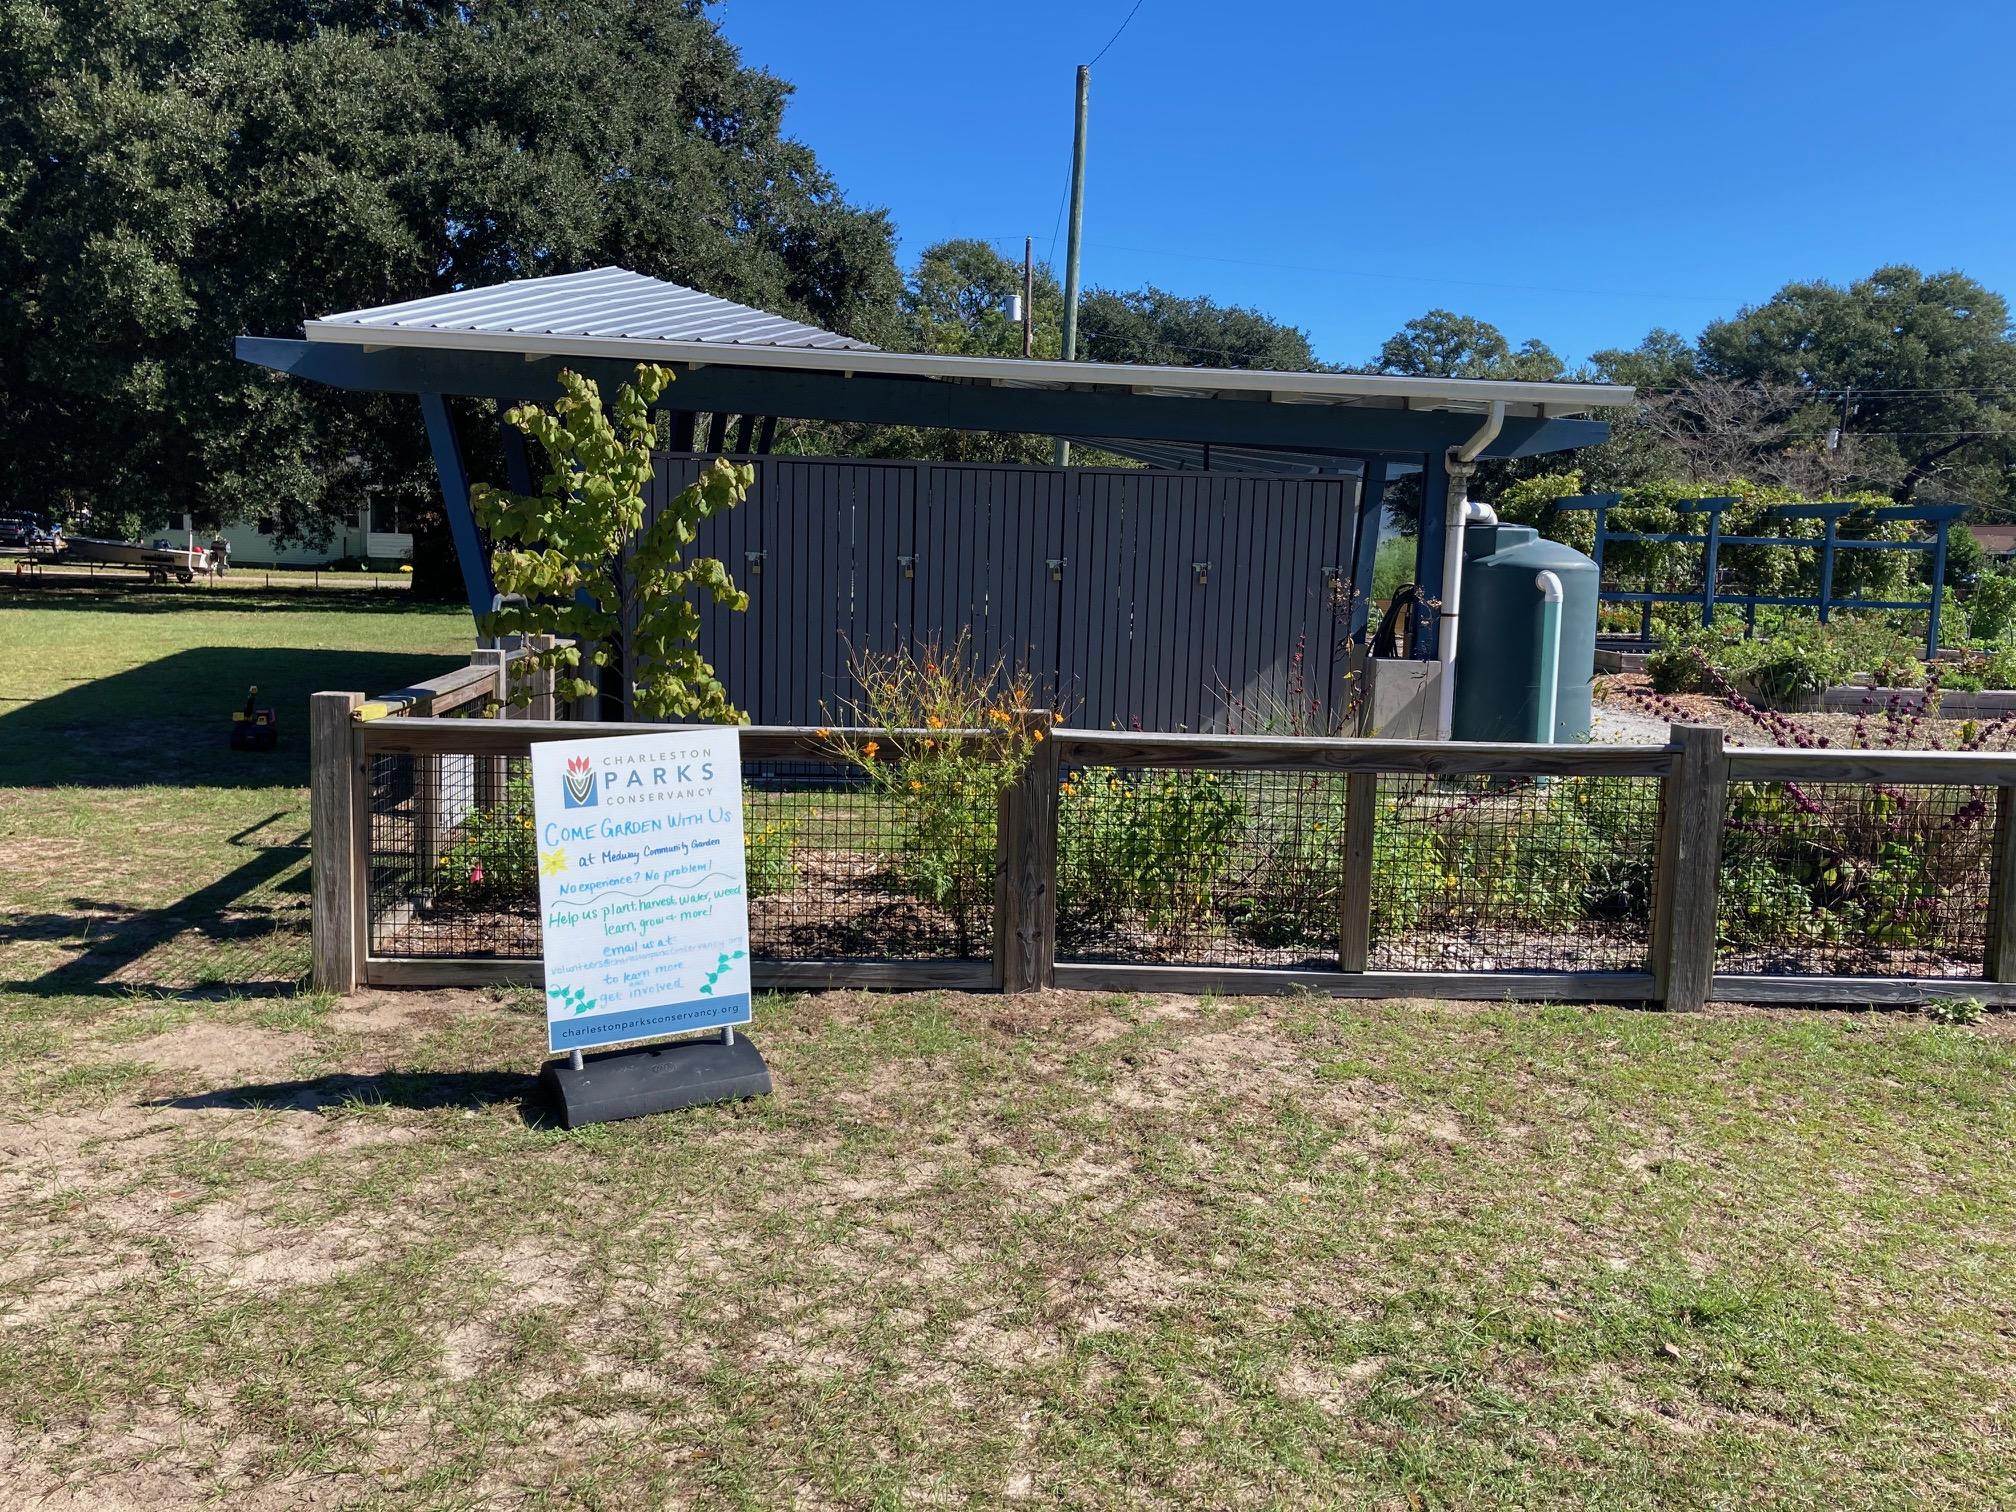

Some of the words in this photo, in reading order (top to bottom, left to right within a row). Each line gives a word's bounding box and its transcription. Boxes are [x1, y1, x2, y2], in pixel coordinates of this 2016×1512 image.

[602, 748, 712, 767] CHARLESTON
[604, 762, 714, 790] PARKS
[606, 786, 714, 806] CONSERVANCY
[578, 852, 596, 867] at
[601, 849, 640, 865] Medway
[643, 841, 689, 857] Community
[691, 837, 720, 849] Garden
[559, 883, 577, 896] No
[578, 871, 641, 894] experience?
[645, 870, 660, 881] No
[663, 858, 712, 883] problem!
[548, 910, 579, 929] Help
[582, 908, 598, 920] us
[713, 884, 742, 899] weed
[604, 921, 637, 937] learn,
[639, 915, 664, 937] grow
[680, 903, 712, 921] more!
[602, 941, 638, 957] email
[642, 941, 655, 949] us
[657, 935, 674, 948] at
[602, 973, 620, 985] to
[655, 961, 684, 974] more
[629, 977, 684, 998] involved
[561, 1004, 740, 1039] charlestonparksconservancy.org
